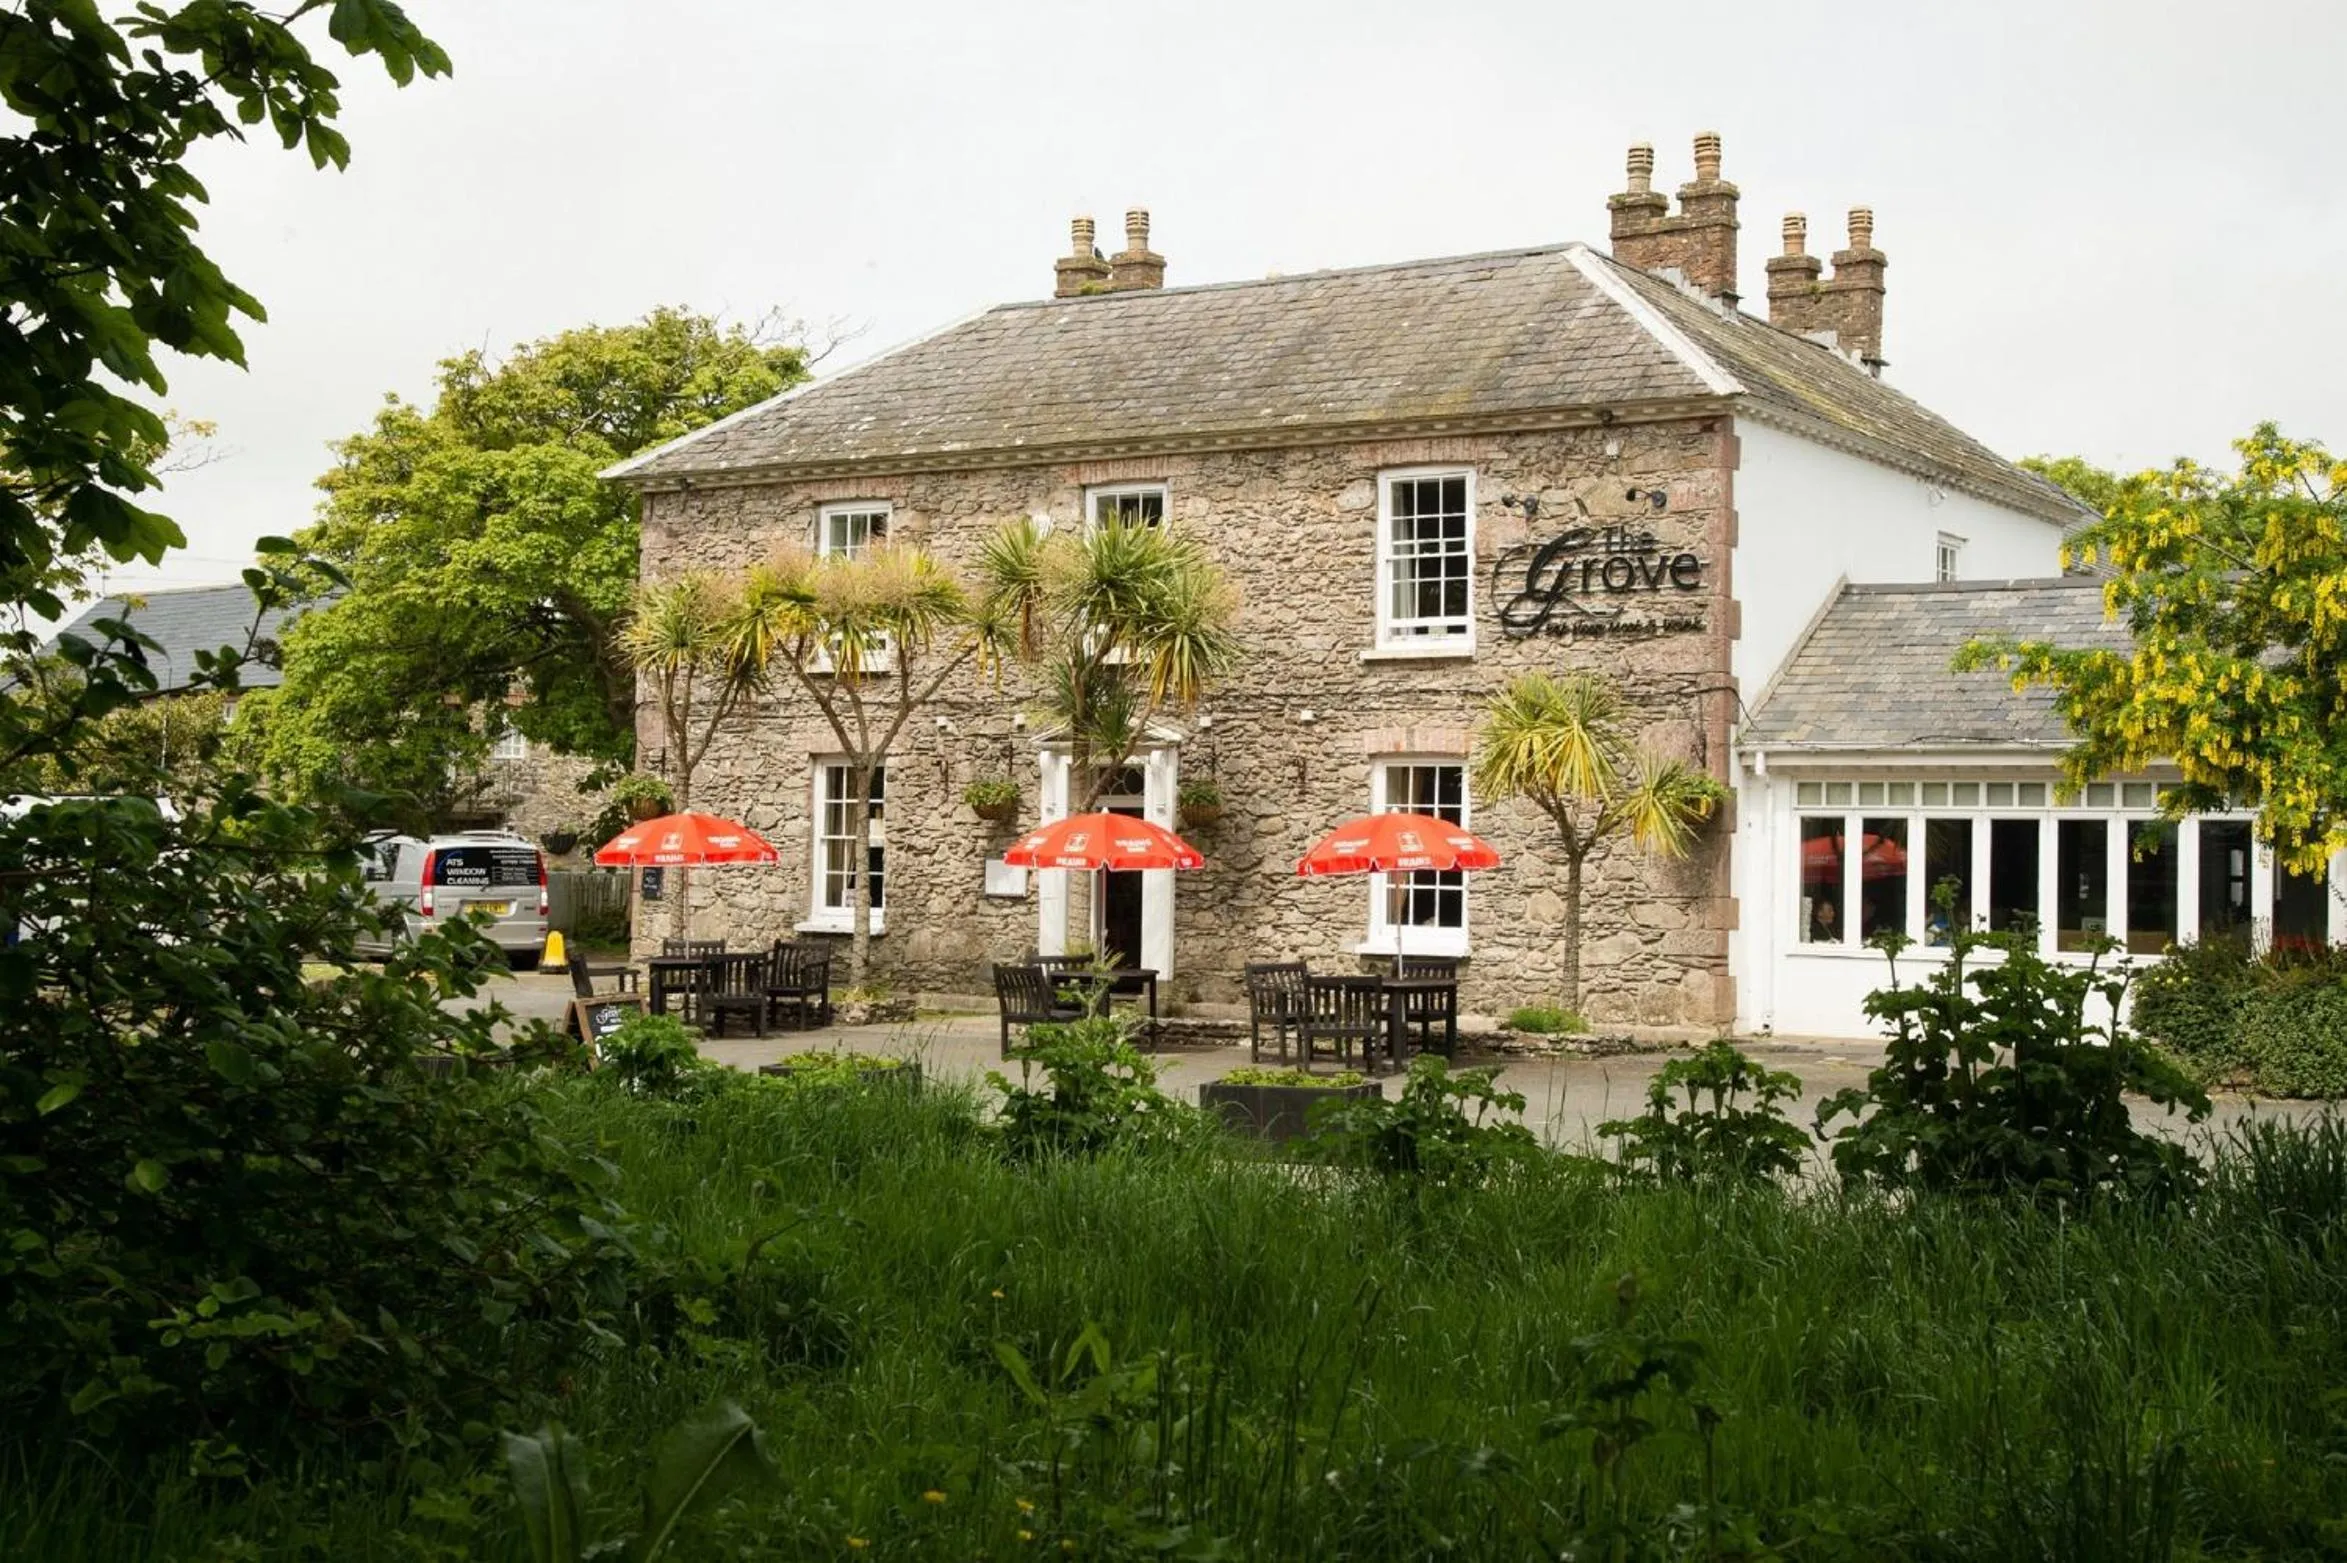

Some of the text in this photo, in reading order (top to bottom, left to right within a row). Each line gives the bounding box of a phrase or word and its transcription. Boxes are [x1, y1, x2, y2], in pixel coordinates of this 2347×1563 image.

[1603, 526, 1657, 551] The
[1491, 527, 1701, 638] Grove
[446, 858, 464, 867] ATS
[446, 867, 487, 876] WINDOW
[447, 877, 490, 885] CLEANING
